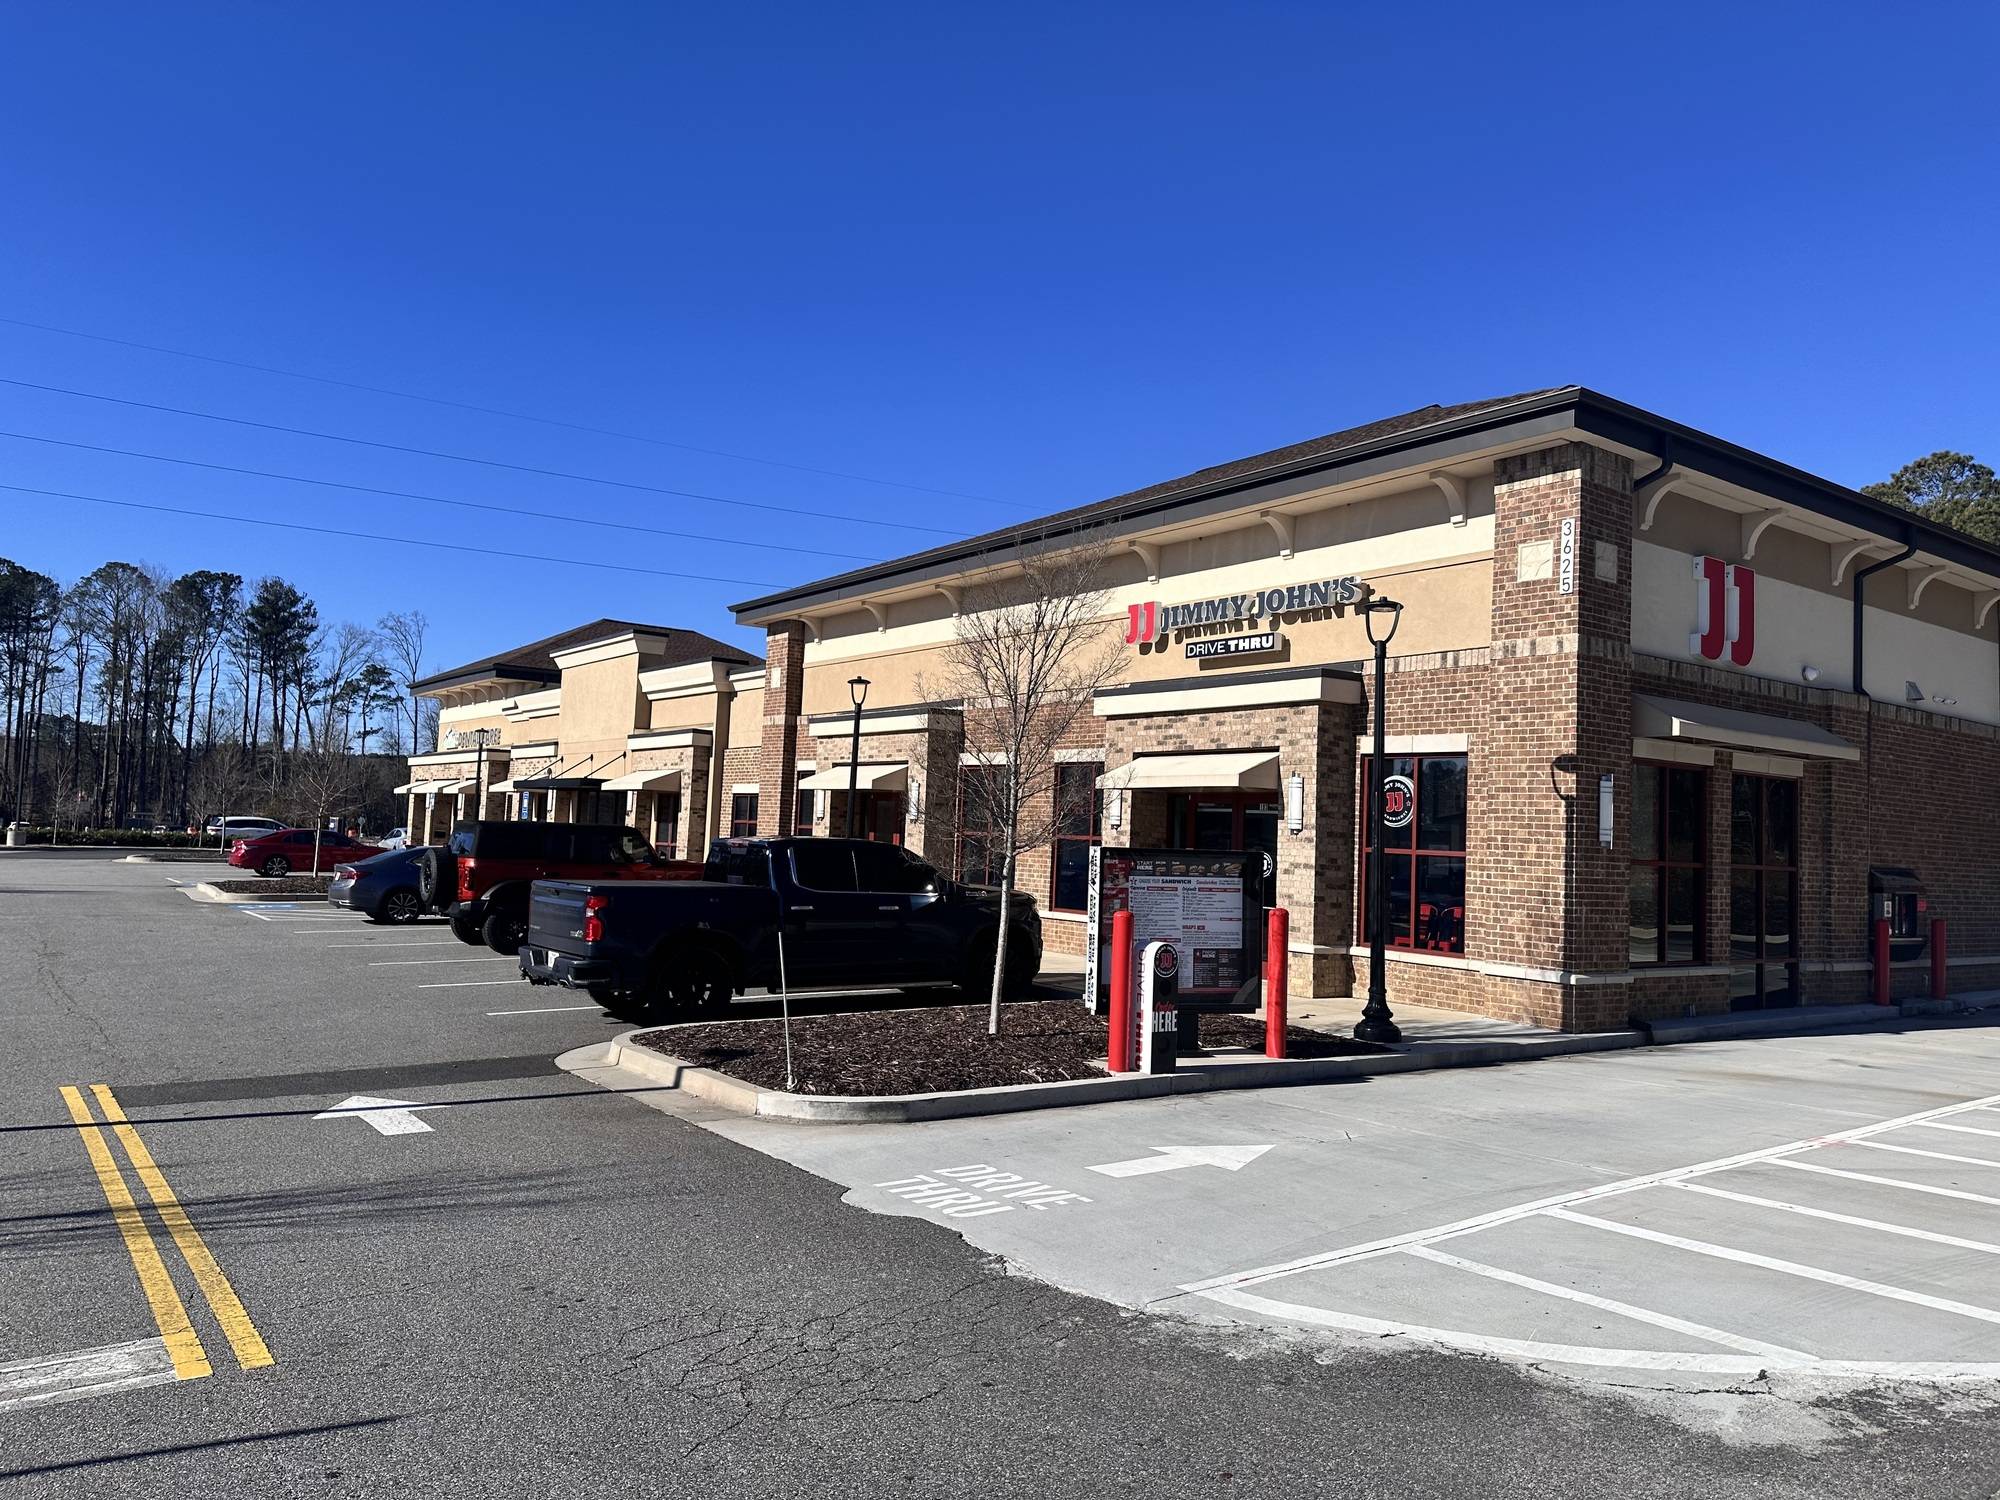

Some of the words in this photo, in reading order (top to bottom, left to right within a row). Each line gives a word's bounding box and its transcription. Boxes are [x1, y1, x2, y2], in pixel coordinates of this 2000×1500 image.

[1562, 521, 1573, 593] 3625
[1125, 601, 1157, 644] JJ
[1161, 594, 1249, 634] JIMMY
[1255, 576, 1360, 620] JOHN'S
[1699, 556, 1755, 667] JJ
[1187, 641, 1226, 657] DRIVE
[1228, 634, 1274, 652] THRU
[1386, 791, 1403, 812] JJ
[1135, 1010, 1143, 1072] THRU
[1152, 1011, 1178, 1033] HERE
[872, 1174, 1016, 1218] THRU
[932, 1163, 1094, 1210] DRIVE
